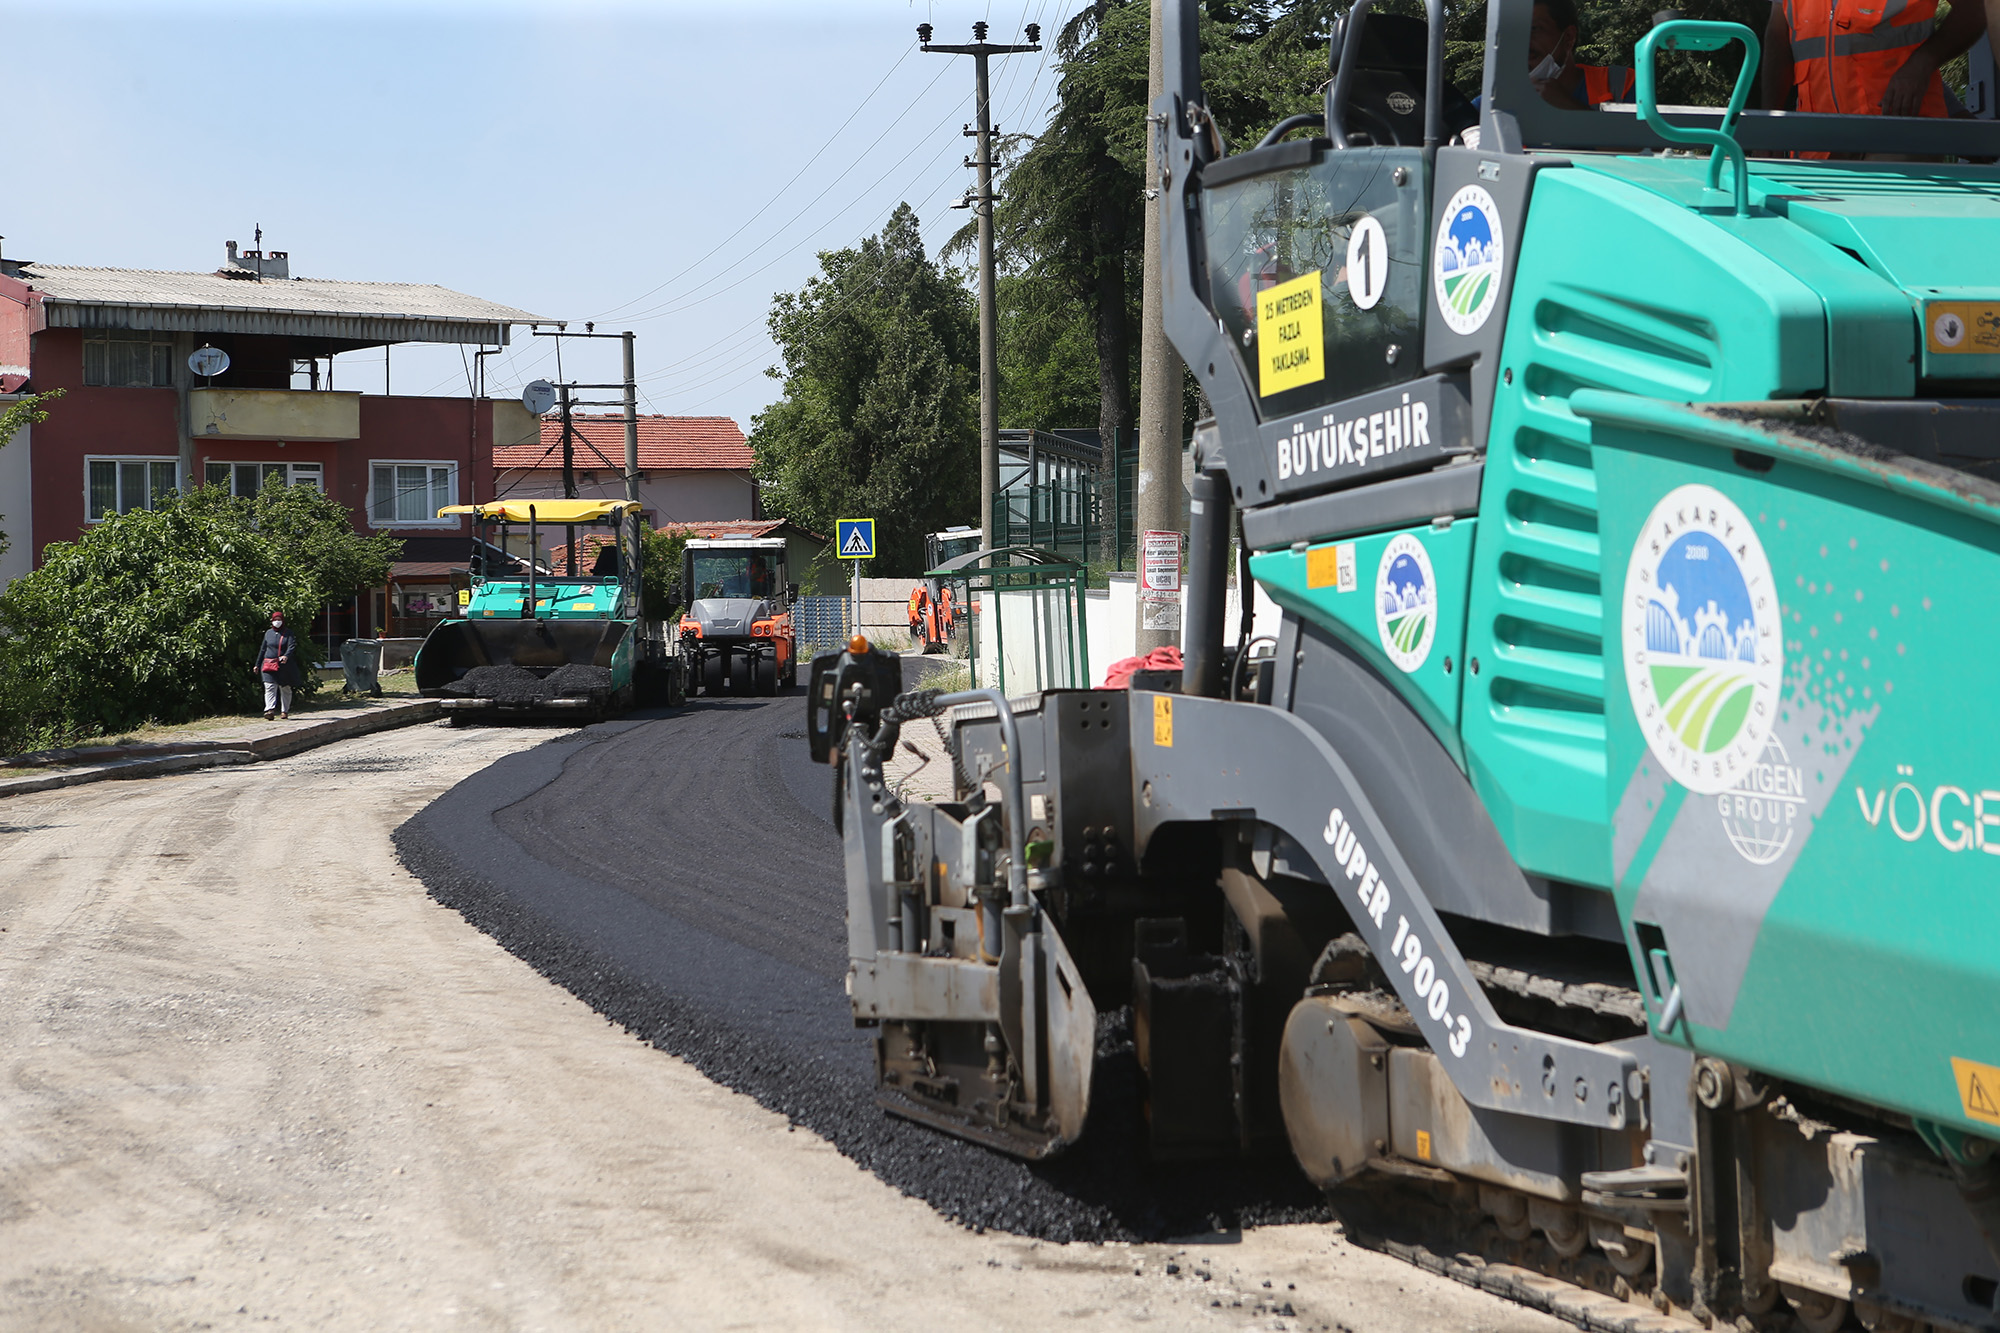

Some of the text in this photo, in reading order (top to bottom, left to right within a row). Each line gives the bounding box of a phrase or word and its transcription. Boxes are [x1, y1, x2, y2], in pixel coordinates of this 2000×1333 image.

[1357, 228, 1371, 297] 1
[1265, 287, 1314, 320] 25 METREDEN
[1279, 320, 1302, 343] FAZLA
[1271, 346, 1311, 373] YAKLAŞMA
[1277, 392, 1431, 481] BÜYÜKŞEHİR
[1651, 506, 1747, 560] SAKARYA
[1685, 545, 1709, 561] 2000
[580, 585, 594, 594] 2
[1717, 794, 1797, 825] GROUP
[1323, 807, 1472, 1058] SUPER 1900-3
